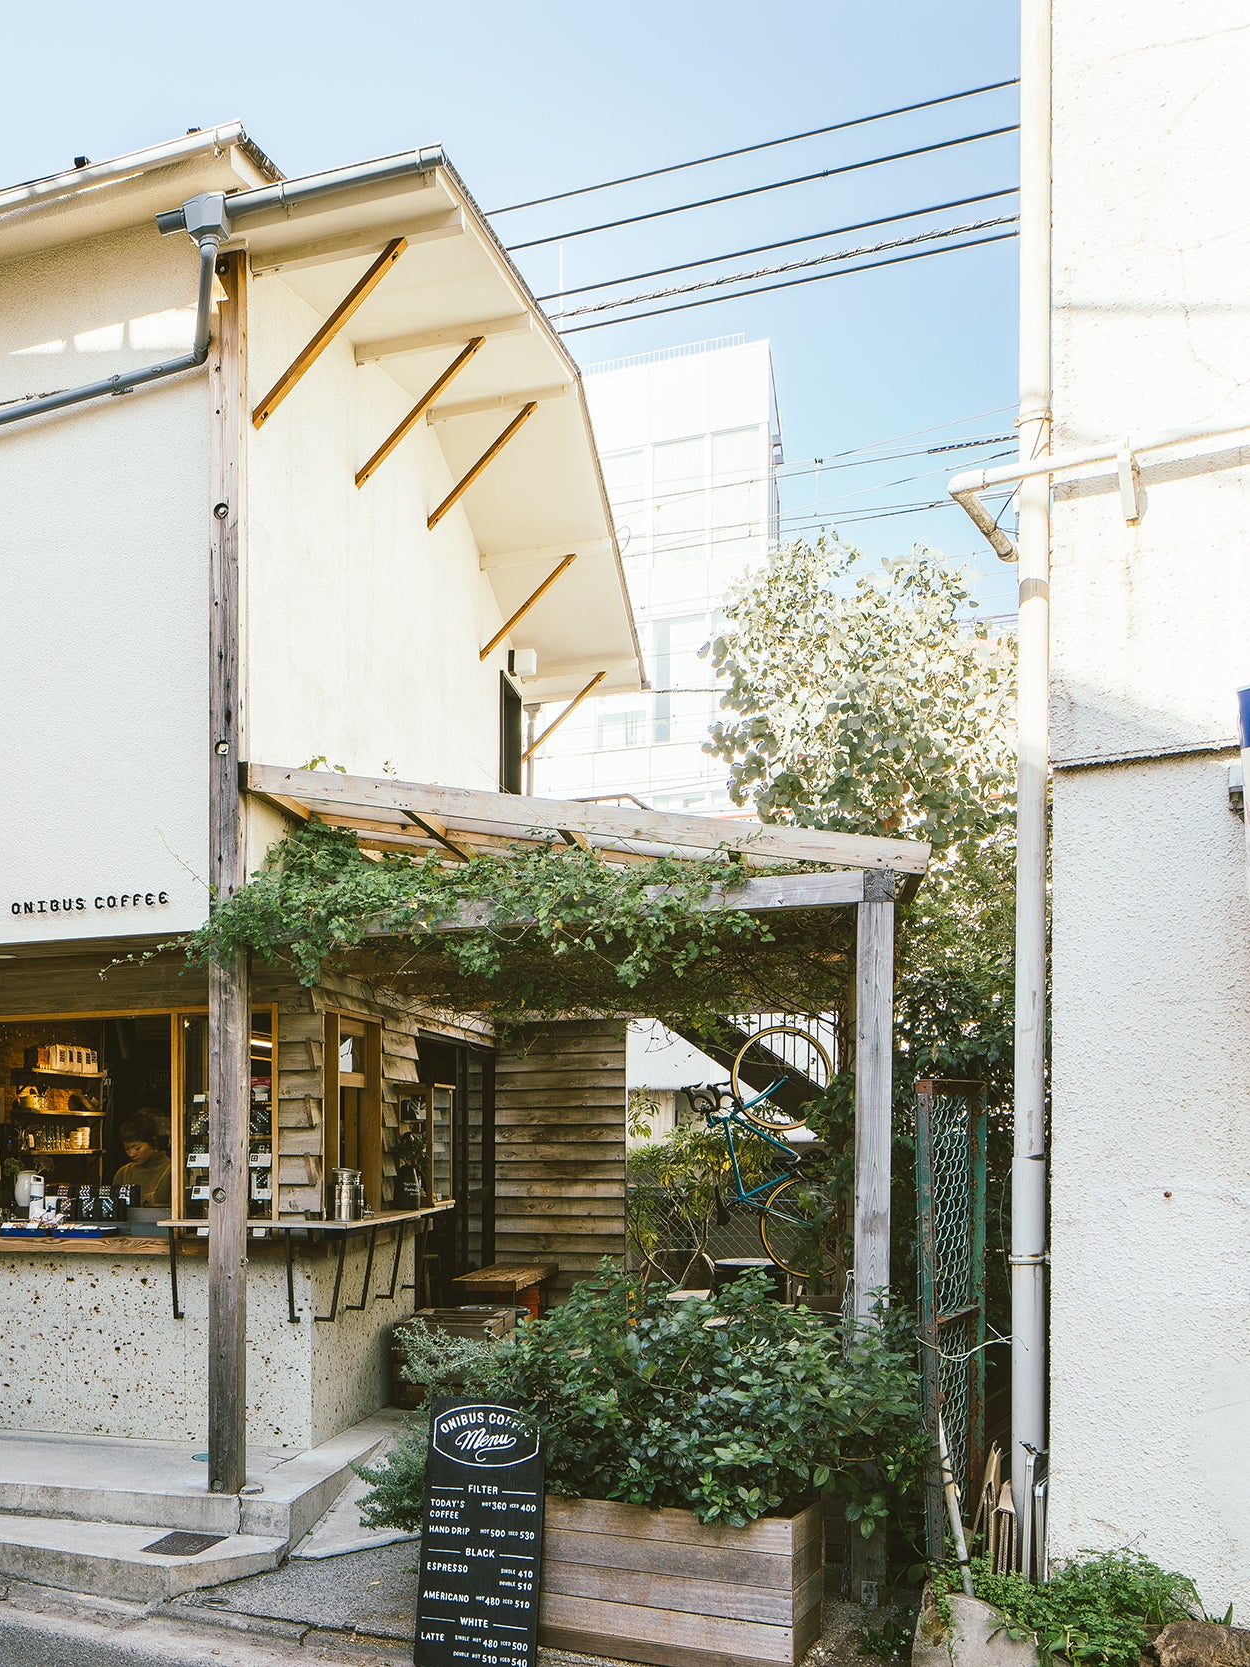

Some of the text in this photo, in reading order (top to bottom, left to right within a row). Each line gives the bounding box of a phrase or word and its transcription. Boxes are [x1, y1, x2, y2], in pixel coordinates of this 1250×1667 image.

[11, 891, 169, 915] ONIBUS COFFEE
[440, 1411, 485, 1434] ONIBUS
[455, 1427, 517, 1462] Menu
[468, 1484, 499, 1495] FILTER
[430, 1498, 466, 1509] TODAY'S
[492, 1502, 508, 1511] 360
[520, 1504, 537, 1513] 400
[429, 1510, 460, 1520] COFFEE
[428, 1524, 450, 1534] HAND
[451, 1526, 471, 1536] DRIP
[490, 1528, 506, 1538] 500
[519, 1530, 535, 1540] 530
[465, 1547, 496, 1559] BLACK
[426, 1561, 469, 1574] ESPRESSO
[517, 1570, 534, 1579] 410
[517, 1582, 533, 1591] 510
[422, 1590, 470, 1603] AMERICANO
[484, 1596, 500, 1606] 480
[514, 1600, 530, 1609] 510
[459, 1616, 489, 1628] WHITE
[420, 1632, 445, 1642] LATTE
[482, 1639, 498, 1648] 480
[512, 1642, 528, 1652] 500
[482, 1654, 498, 1664] 510
[510, 1658, 528, 1667] 540
